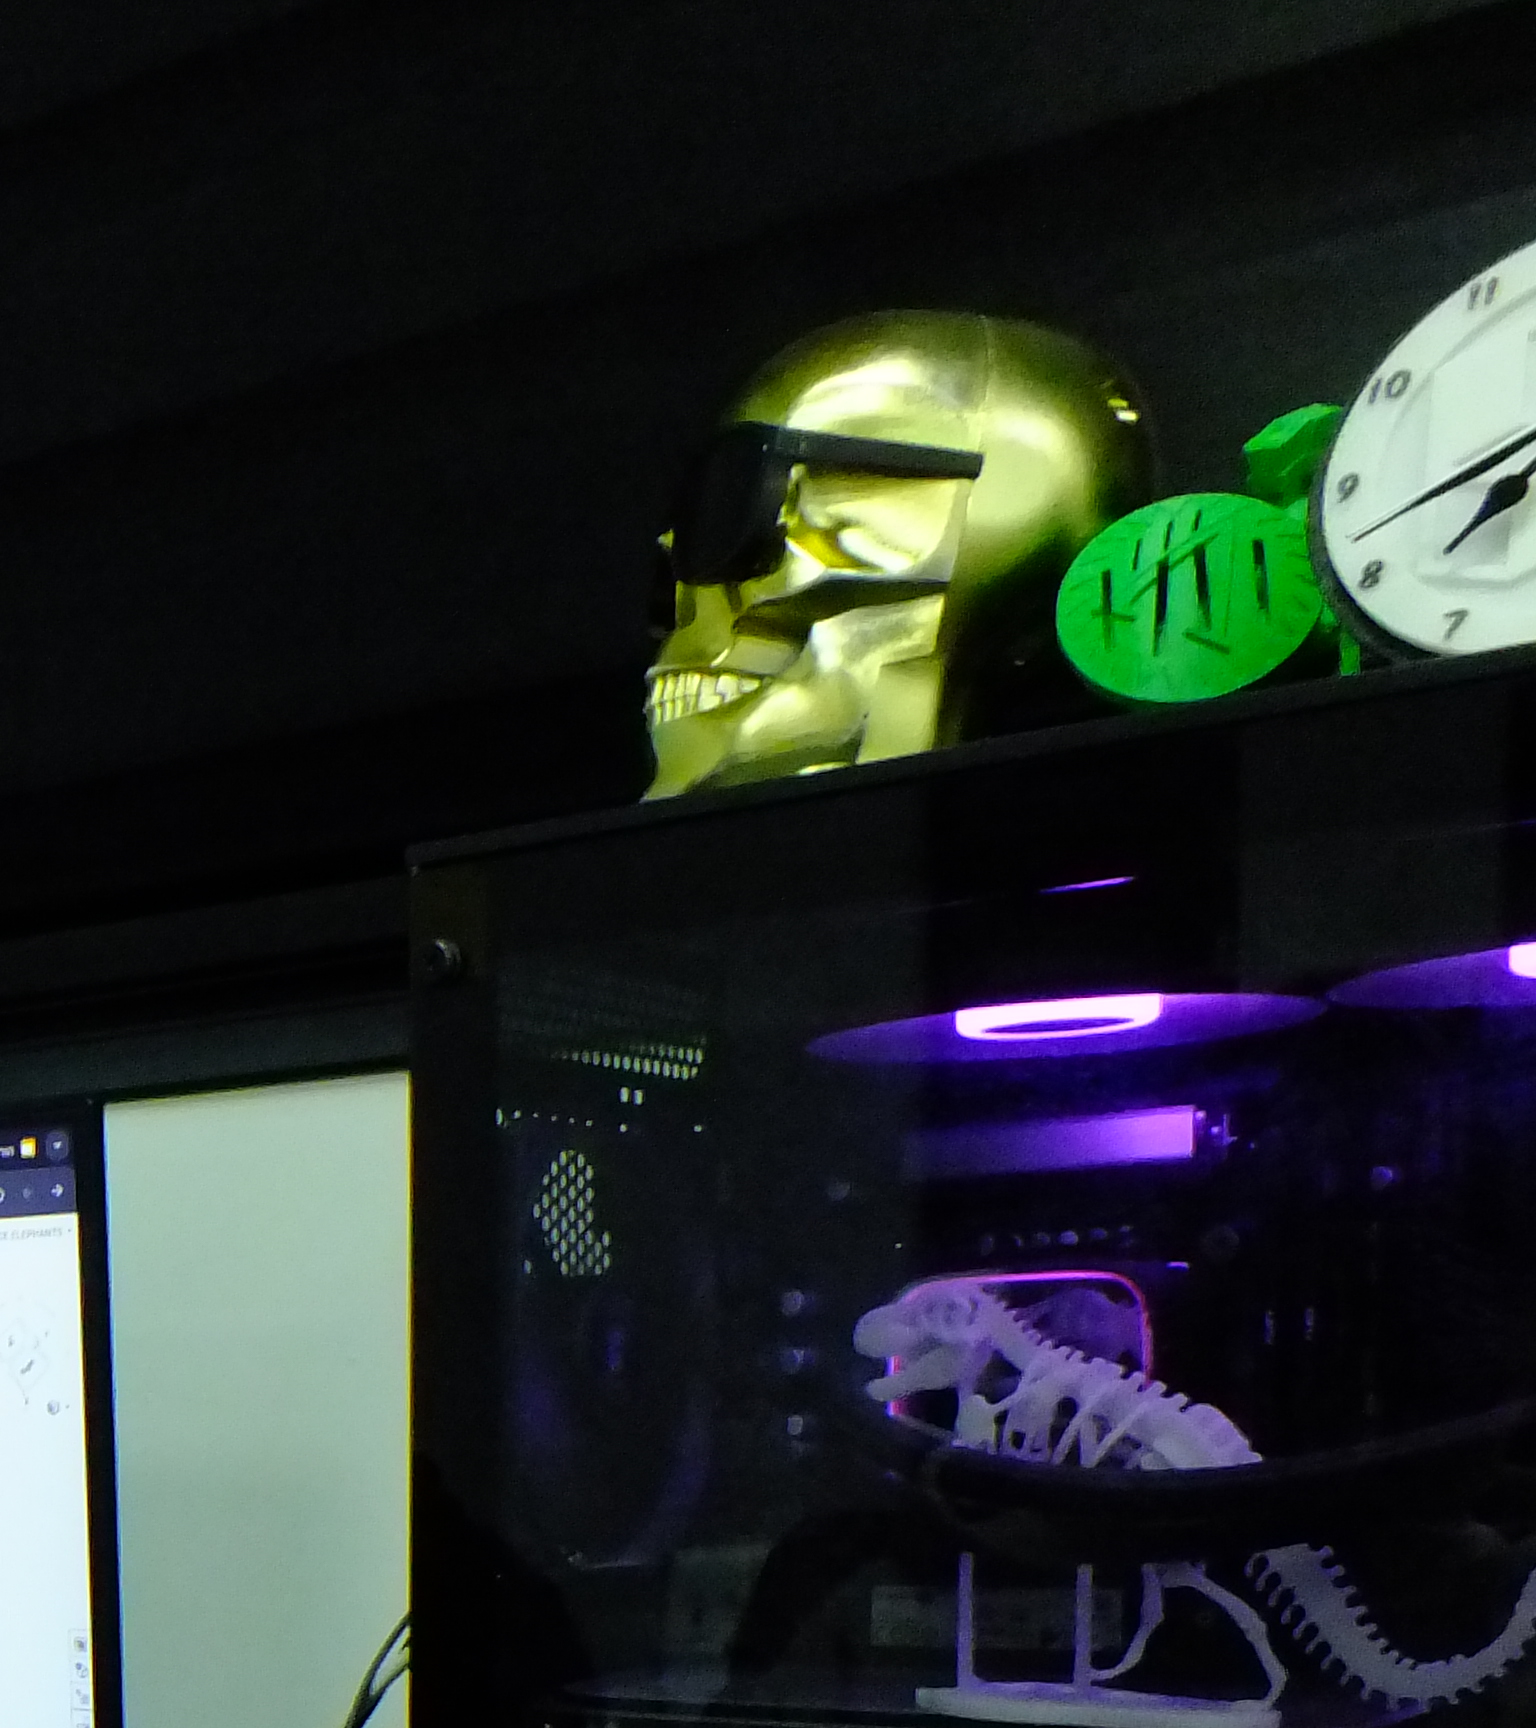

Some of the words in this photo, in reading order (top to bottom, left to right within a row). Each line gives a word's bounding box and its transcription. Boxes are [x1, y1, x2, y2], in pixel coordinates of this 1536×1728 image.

[1467, 276, 1499, 310] 11
[1368, 369, 1411, 404] 10
[1338, 473, 1359, 503] 9
[1359, 559, 1383, 590] 8
[1444, 609, 1469, 640] 7
